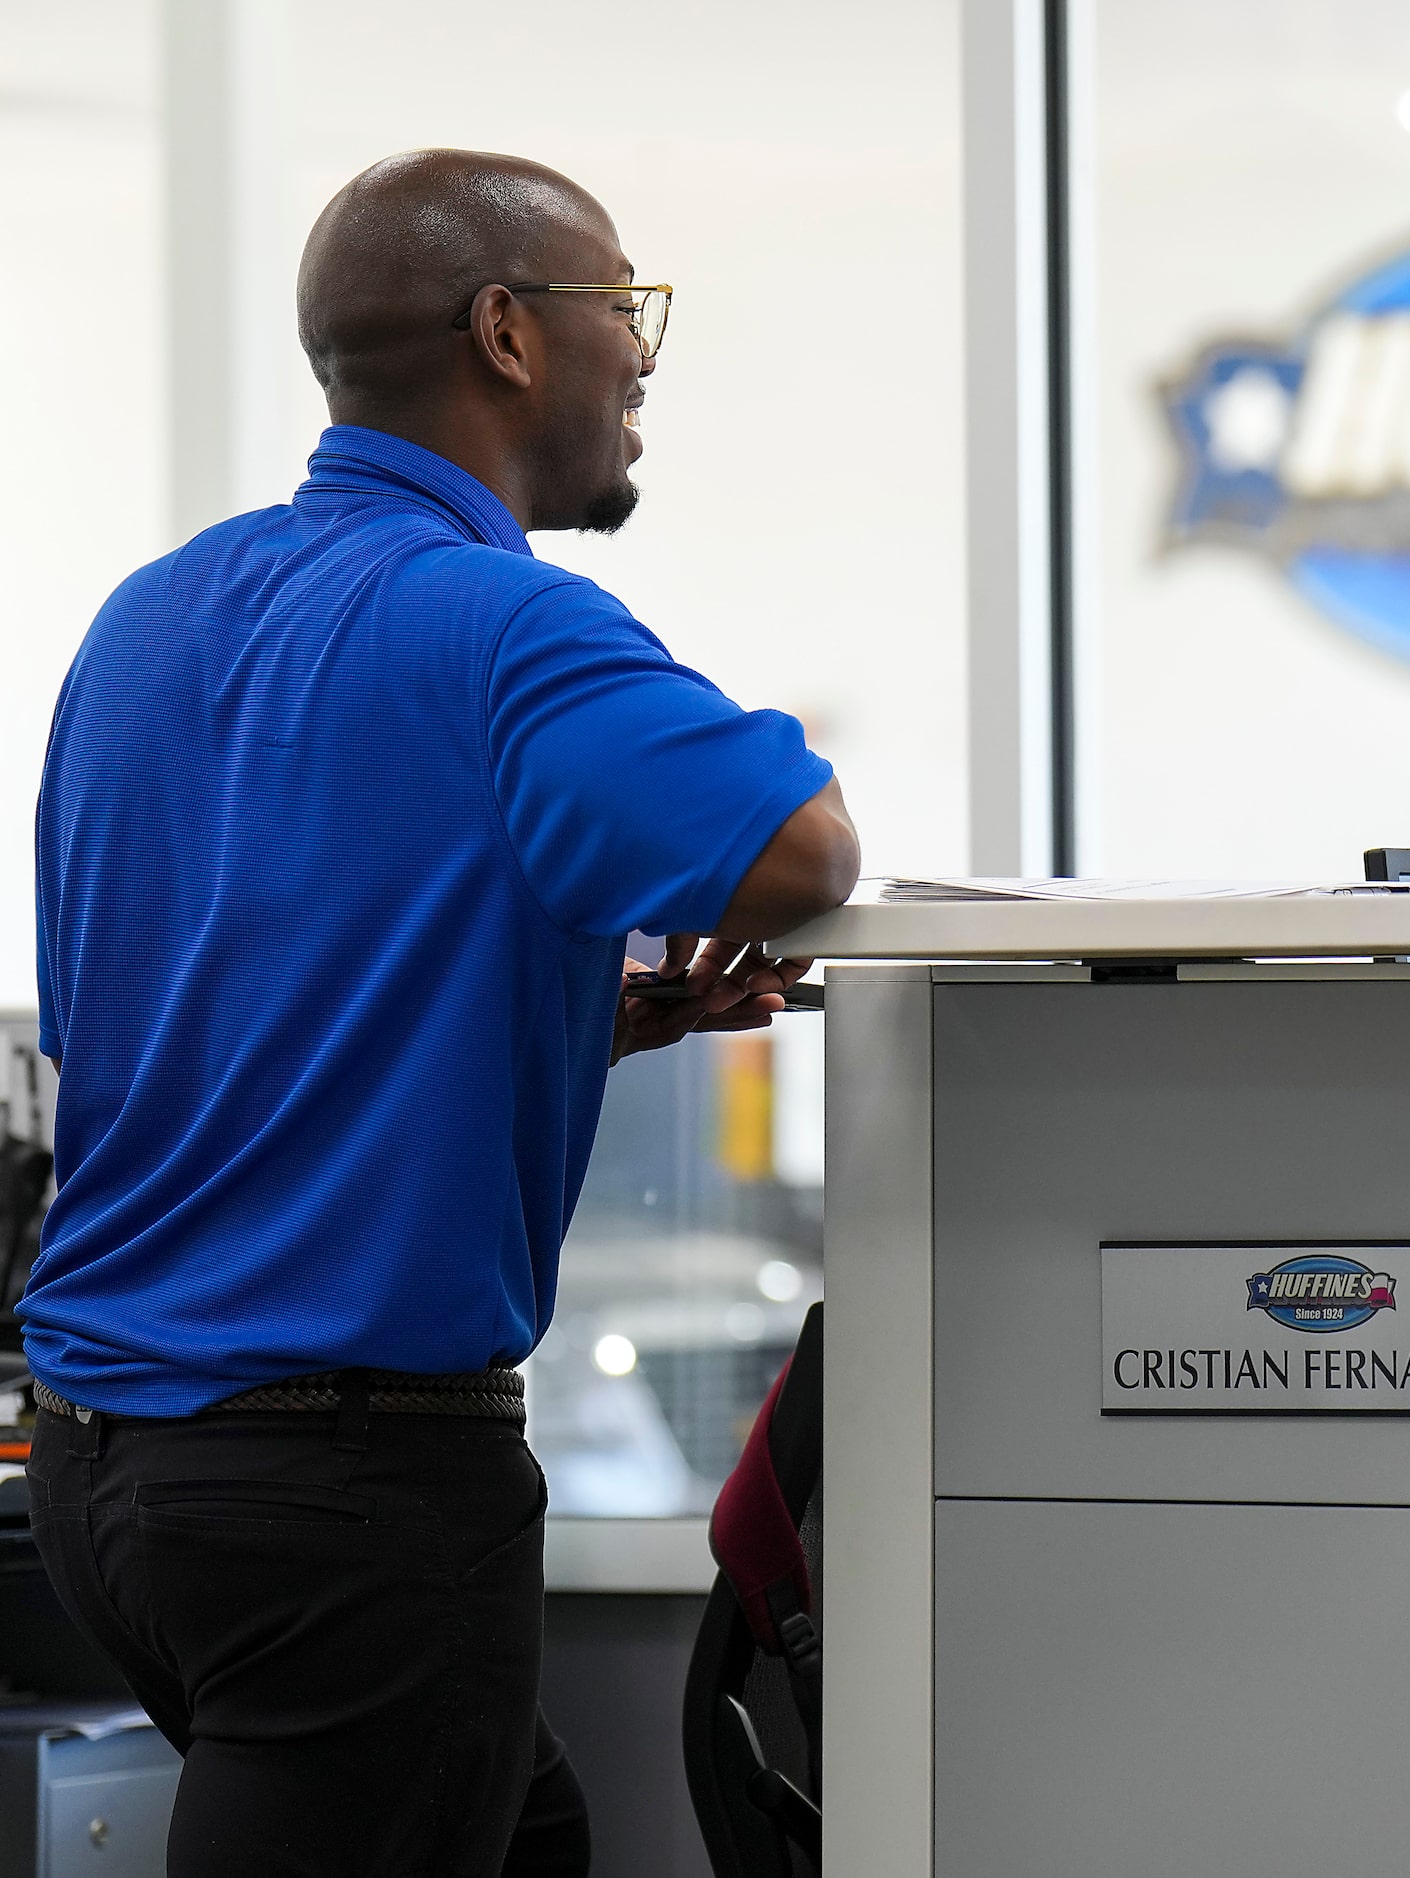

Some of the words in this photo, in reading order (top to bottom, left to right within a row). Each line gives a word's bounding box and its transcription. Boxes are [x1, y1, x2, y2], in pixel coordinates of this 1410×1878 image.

[1268, 1273, 1375, 1300] HUFFINES
[1295, 1308, 1321, 1320] Since
[1322, 1308, 1344, 1320] 1924
[1113, 1349, 1289, 1389] CRISTIAN
